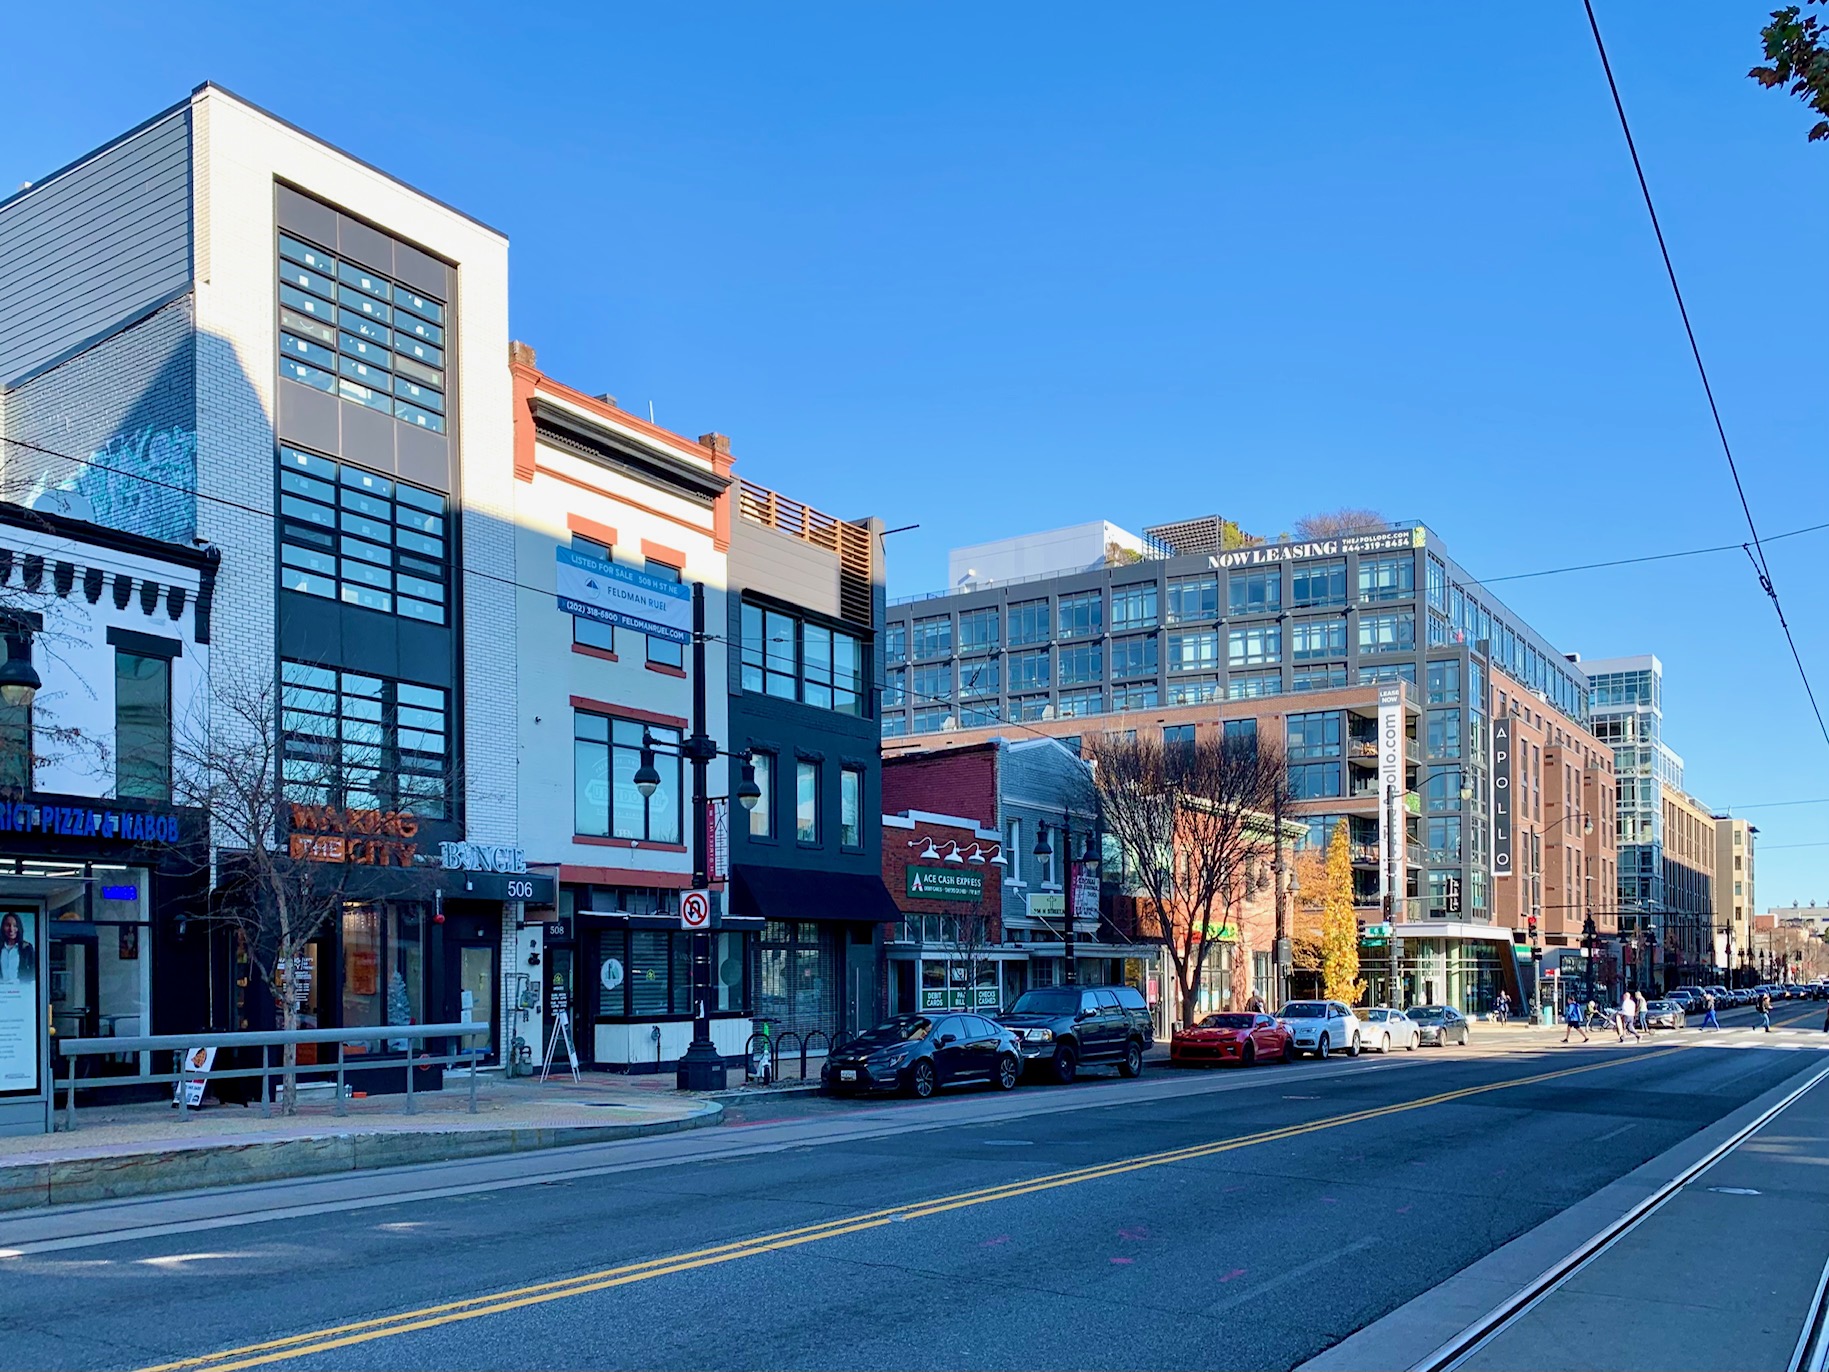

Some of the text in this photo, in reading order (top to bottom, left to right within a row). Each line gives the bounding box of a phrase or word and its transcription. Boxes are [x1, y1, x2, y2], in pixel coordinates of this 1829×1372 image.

[1342, 531, 1409, 545] THEAPOLLODC.COM
[1342, 539, 1409, 553] 844-319-8454
[1207, 541, 1338, 569] NOW LEASING
[571, 555, 678, 595] LISTED FOR SALE 508 H ST NE
[607, 586, 667, 612] FELDMAN RUEL
[566, 600, 684, 640] (202) 318-6800 FELDMANRUEL.COM
[1379, 689, 1400, 697] LEASE
[1495, 727, 1509, 866] APOLLO
[42, 806, 96, 837] PIZZA
[101, 811, 114, 839] &
[121, 813, 179, 843] KABOB
[299, 837, 418, 867] THE CITY
[508, 881, 533, 898] 506
[924, 874, 981, 887] ACE CASH EXPRESS
[549, 926, 564, 935] 508
